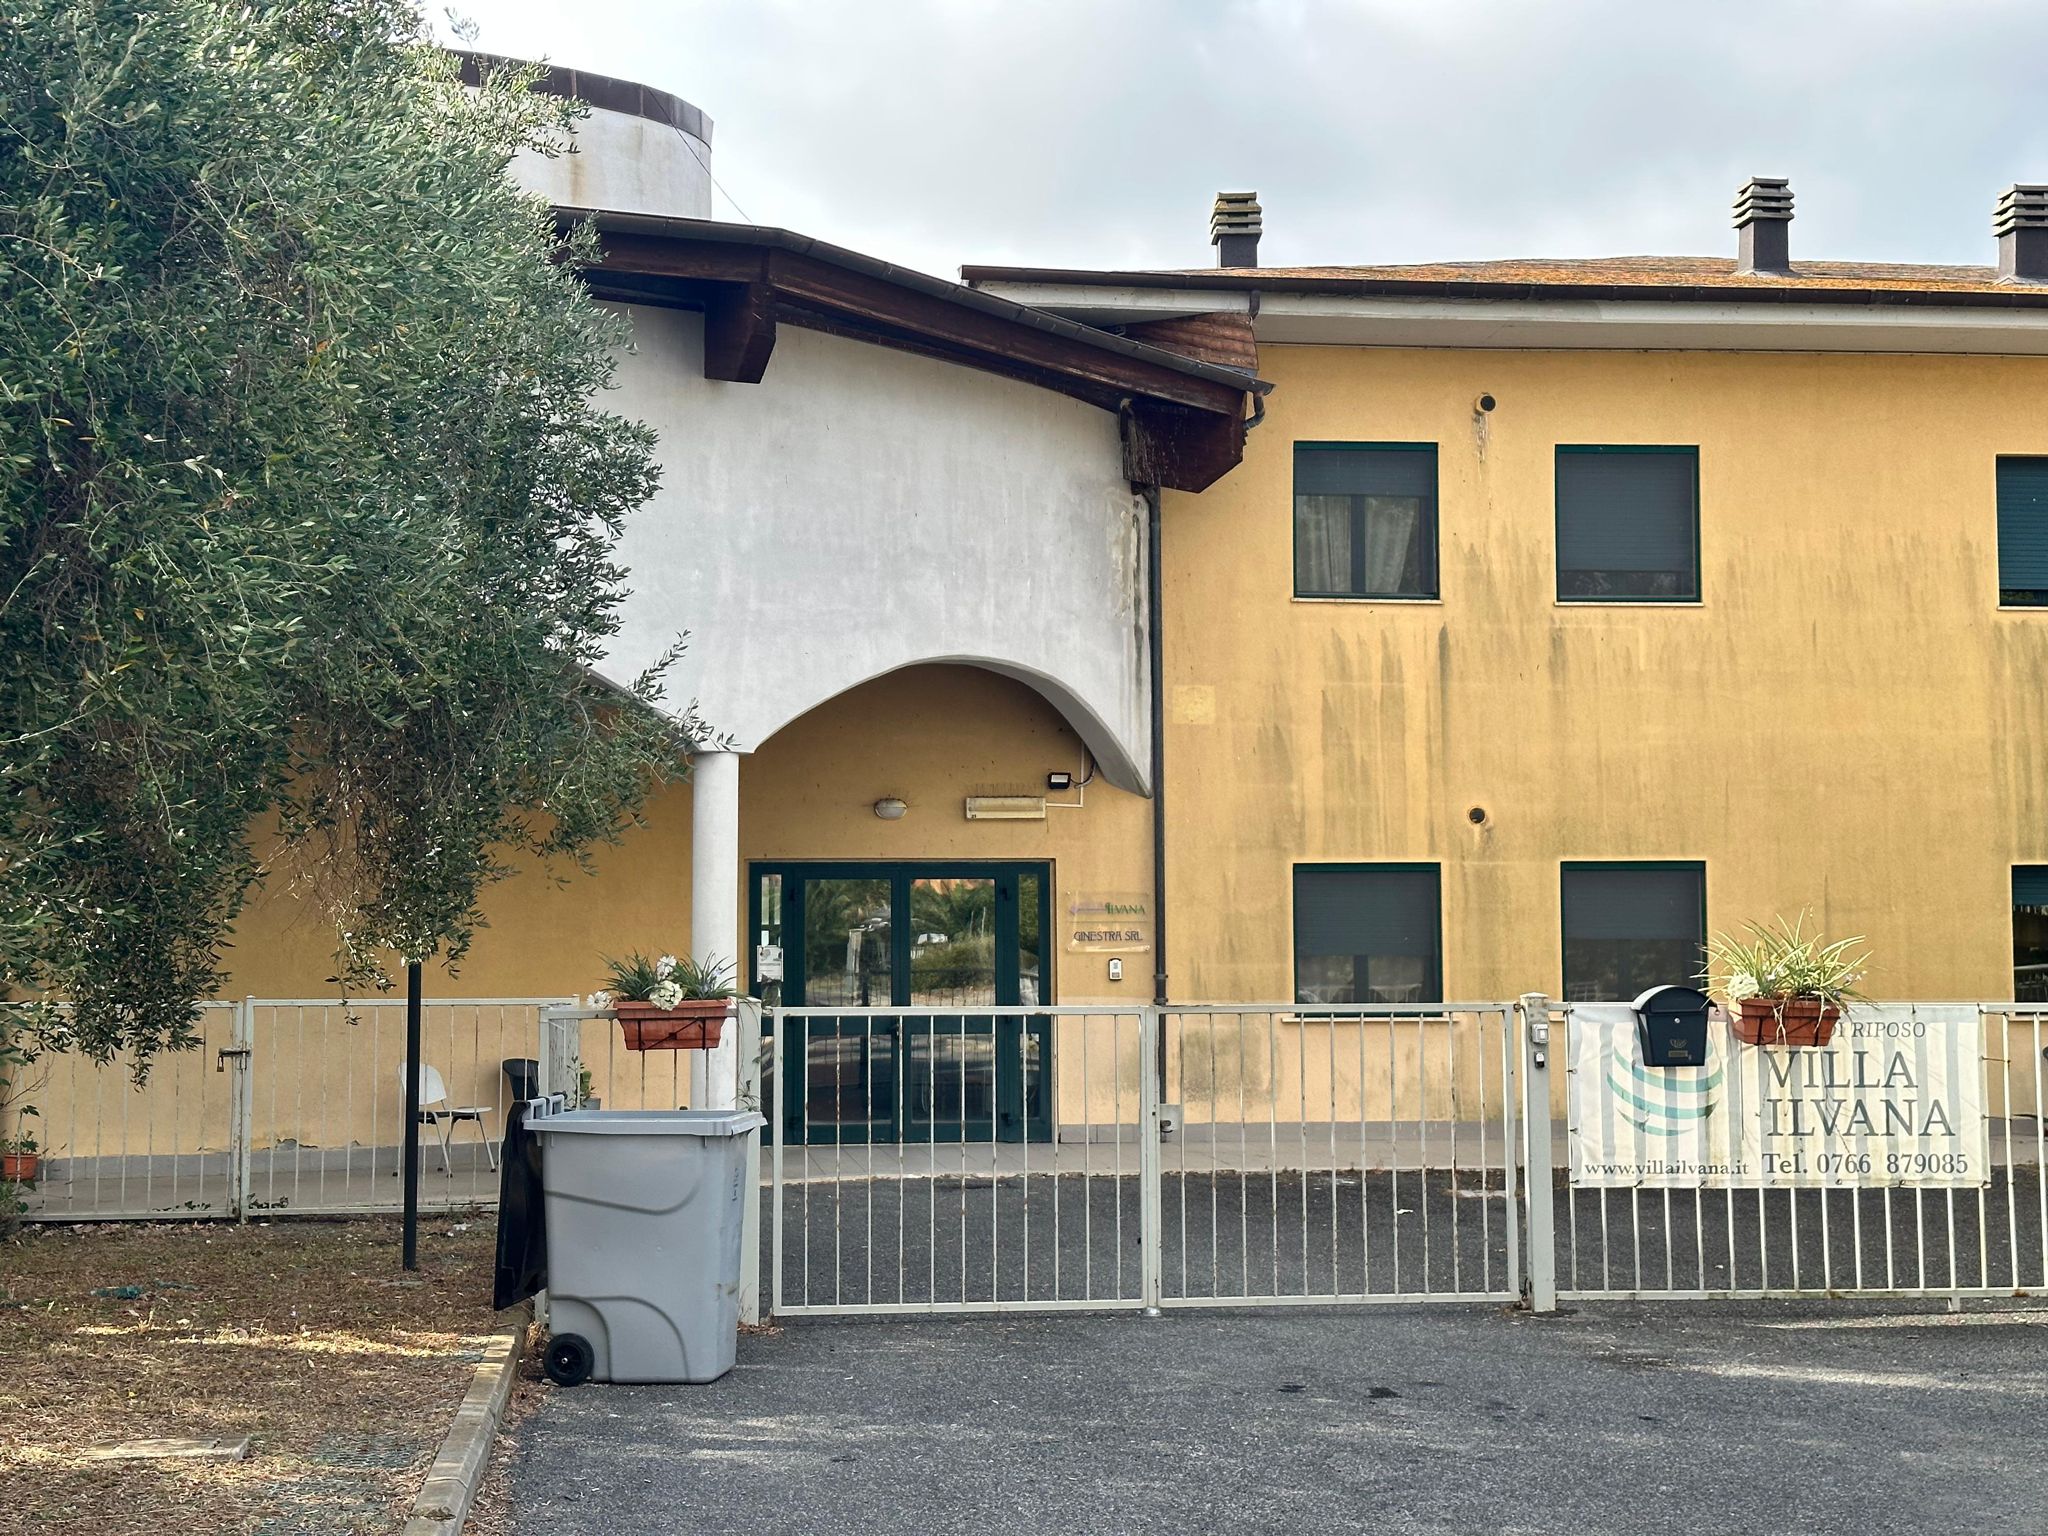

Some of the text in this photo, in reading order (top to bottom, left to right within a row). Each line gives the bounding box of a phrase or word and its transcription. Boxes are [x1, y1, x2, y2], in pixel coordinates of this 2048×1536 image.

[1073, 931, 1144, 942] GINESTRA SRL
[1852, 1021, 1926, 1038] RIPOSO
[1763, 1050, 1919, 1089] VILLA
[1767, 1098, 1956, 1137] ILVANA
[1584, 1159, 1750, 1175] www.villailvana.it
[1761, 1152, 1969, 1175] Tel. 0766 879085
